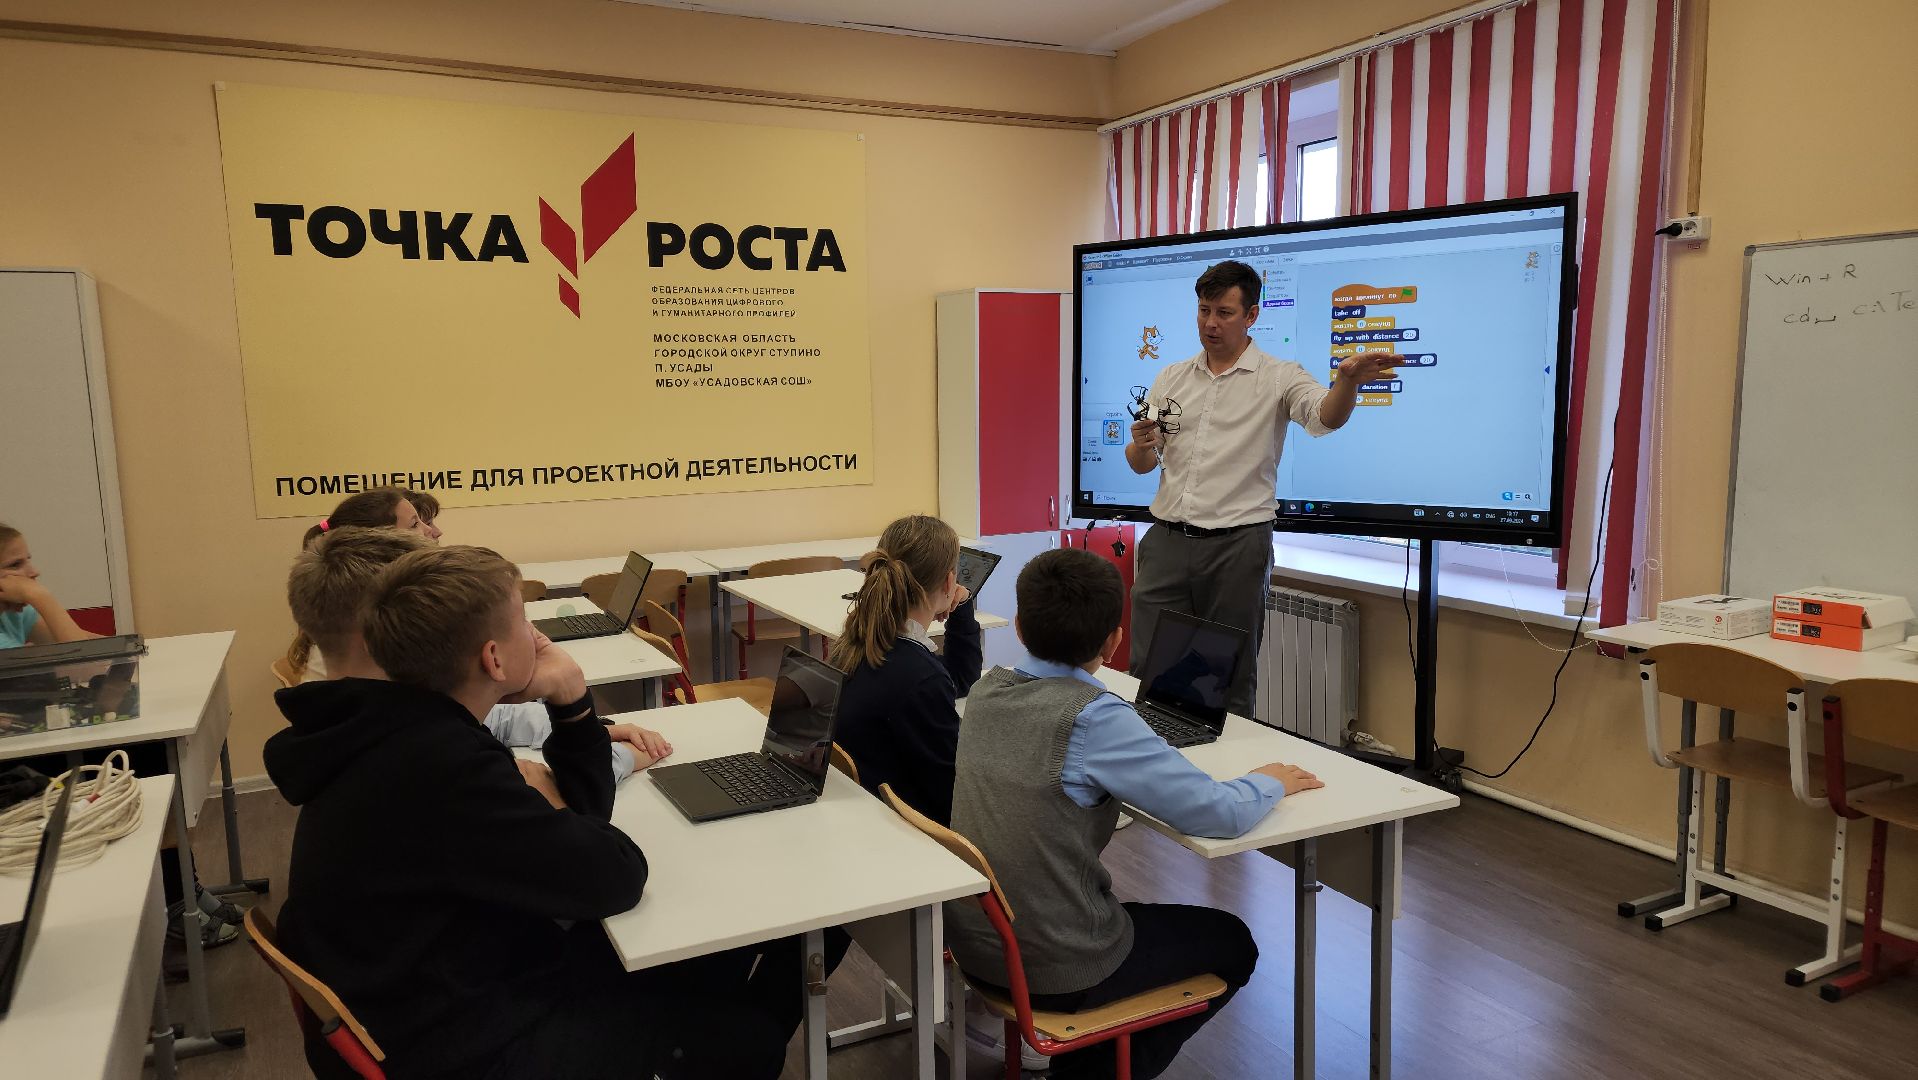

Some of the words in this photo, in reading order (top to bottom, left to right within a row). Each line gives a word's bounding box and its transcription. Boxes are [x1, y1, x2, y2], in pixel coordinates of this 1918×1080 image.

[254, 203, 530, 263] ТОЧКА
[647, 221, 847, 272] РОСТА
[1765, 273, 1811, 286] Win
[1843, 263, 1857, 279] R
[651, 285, 723, 294] ФЕДЕРАЛЬНАЯ
[752, 287, 795, 296] ЦЕНТРОВ
[651, 297, 724, 306] ОБРАЗОВАНИЯ
[726, 298, 784, 307] ЦИФРОВОГО
[652, 309, 659, 317] И
[661, 309, 744, 317] ГУМАНИТАРНОГО
[746, 309, 796, 317] ПРОФИЛЕЙ
[653, 333, 737, 343] МОСКОВСКАЯ
[742, 334, 796, 343] ОБЛАСТЬ
[654, 347, 728, 359] ГОРОДСКОЙ
[730, 348, 767, 358] ОКРУГ
[769, 348, 821, 357] СТУПИНО
[655, 363, 667, 373] П.
[669, 363, 713, 374] УСАДЫ
[656, 378, 690, 388] МБОУ
[693, 377, 778, 388] «УСАДОВСКАЯ
[780, 376, 812, 386] СОШ»
[470, 468, 524, 491] ДЛЯ
[532, 457, 679, 485] ПРОЕКТНОЙ
[685, 453, 857, 481] ДЕЯТЕЛЬНОСТИ
